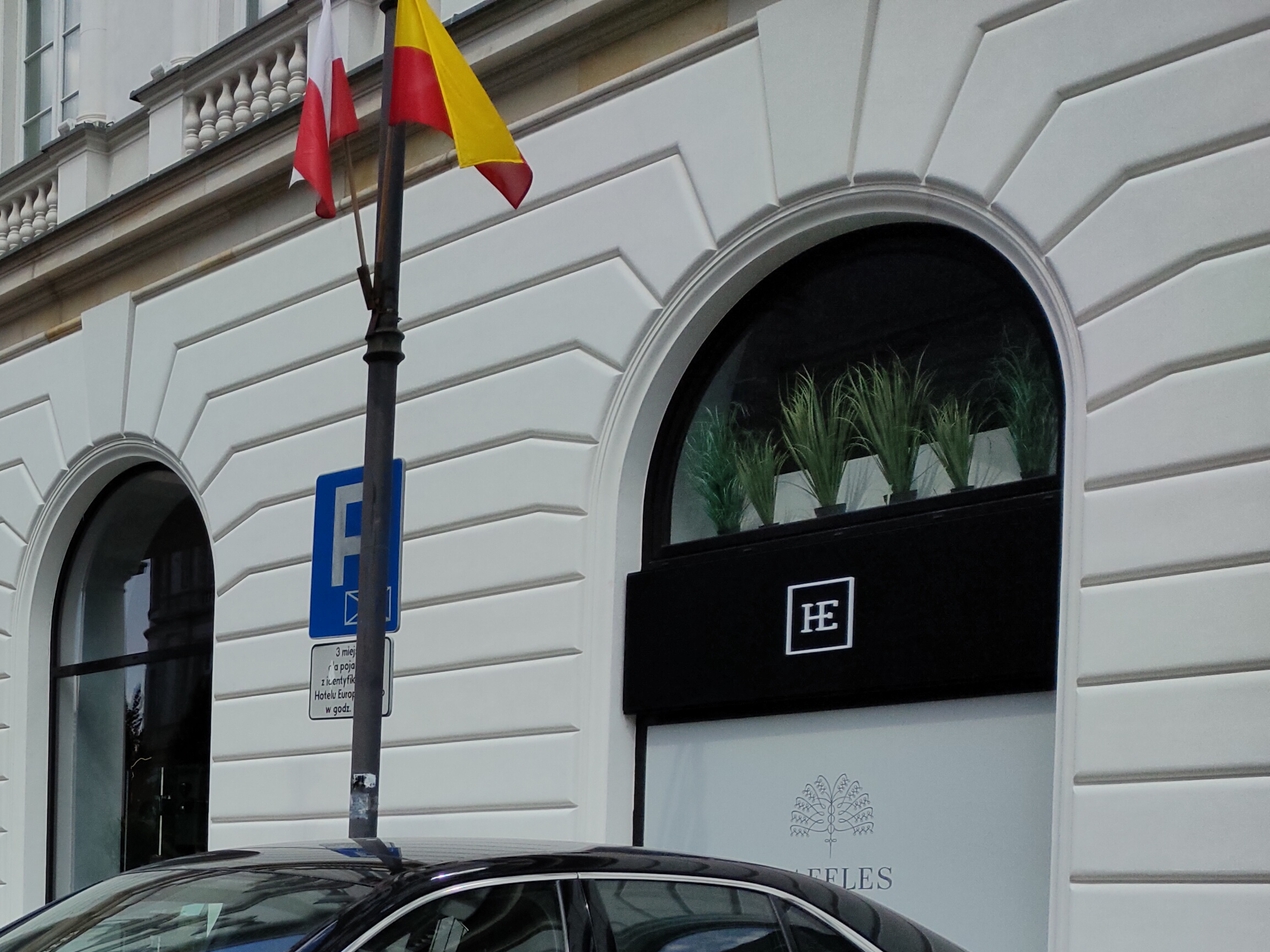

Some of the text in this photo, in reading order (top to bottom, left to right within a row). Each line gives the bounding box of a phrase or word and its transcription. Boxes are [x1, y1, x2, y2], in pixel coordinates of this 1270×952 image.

[800, 599, 839, 634] HE
[335, 645, 357, 658] 3 miej
[339, 660, 356, 674] poja
[314, 690, 337, 701] Hotelu
[332, 703, 352, 716] godz.
